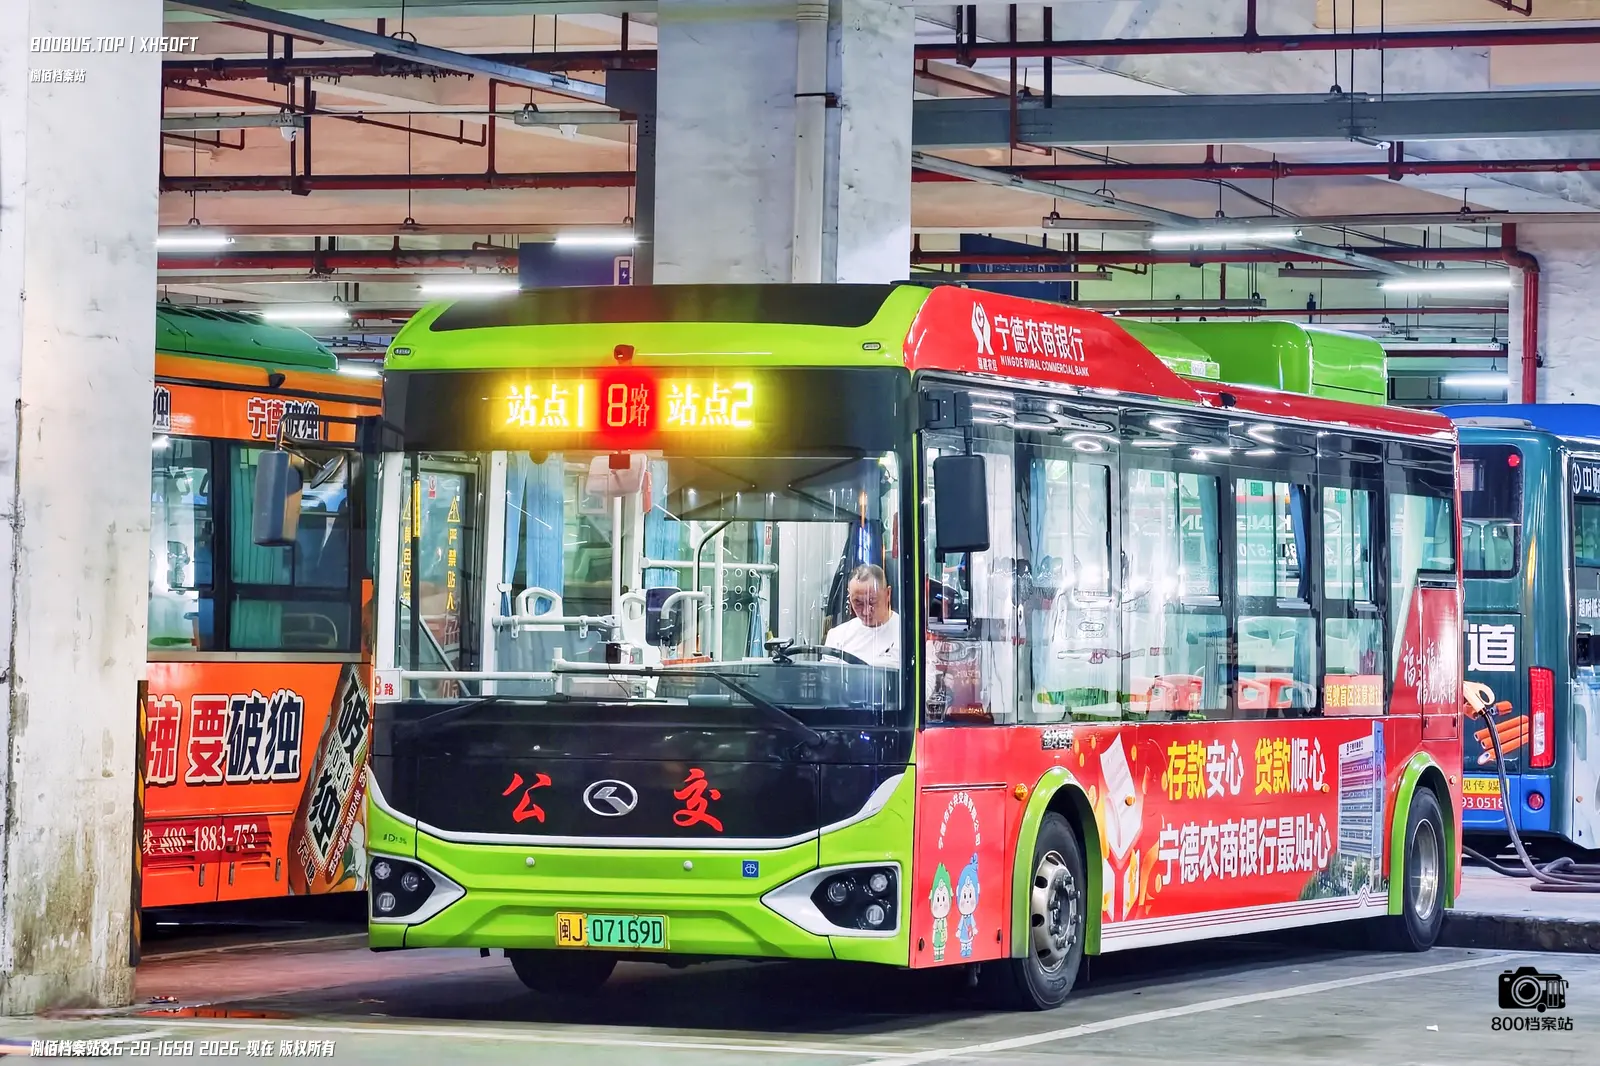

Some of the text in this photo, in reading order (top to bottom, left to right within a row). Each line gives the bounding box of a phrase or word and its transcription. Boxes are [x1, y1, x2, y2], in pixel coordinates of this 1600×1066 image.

[994, 315, 1086, 362] 宁德农商银行
[1000, 355, 1090, 377] NINGDE RURAL COMMERCIAL BANK
[505, 382, 754, 427] 站点1 8路 站点2
[1468, 624, 1515, 671] 道
[1167, 737, 1326, 801] 存款安心 贷款顺心
[502, 768, 723, 832] 公 交
[1158, 813, 1332, 885] 宁德农商银行最贴心
